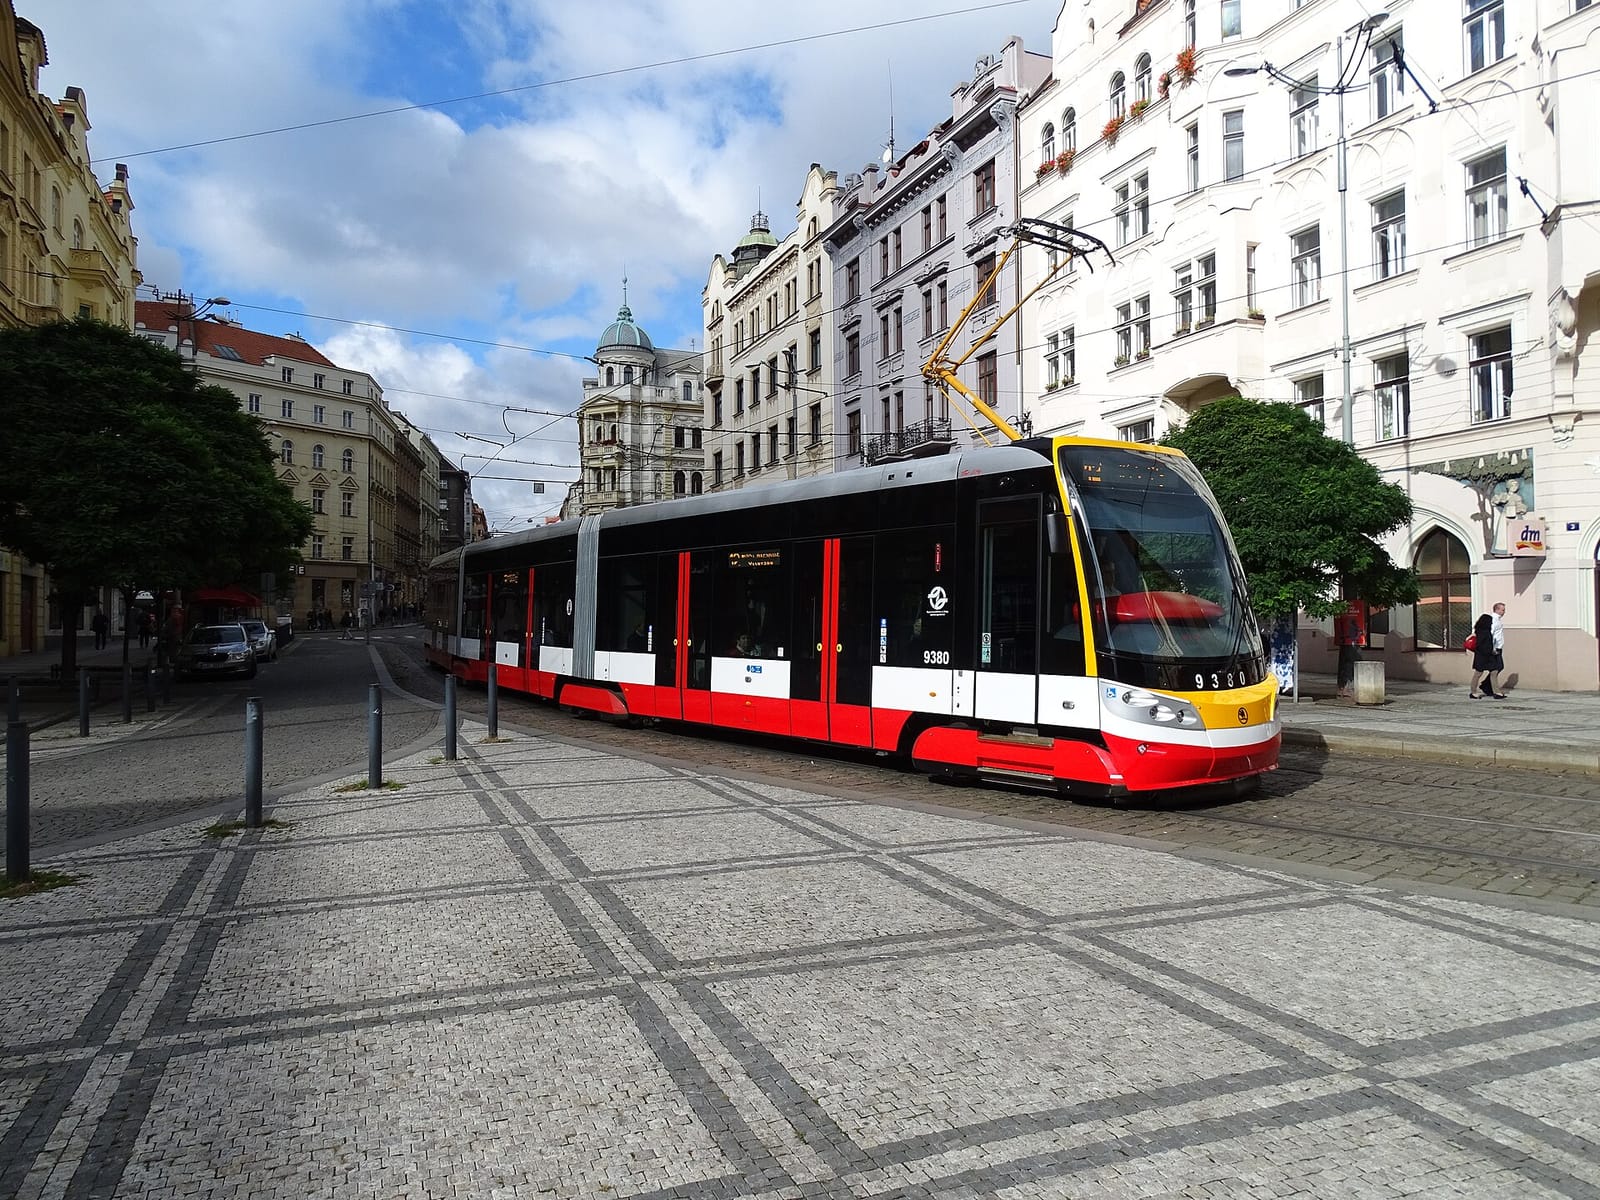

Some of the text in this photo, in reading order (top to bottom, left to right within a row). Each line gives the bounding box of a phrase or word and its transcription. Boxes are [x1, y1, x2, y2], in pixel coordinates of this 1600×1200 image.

[1521, 525, 1540, 541] dm
[923, 650, 950, 665] 9380
[1195, 671, 1245, 689] 9380
